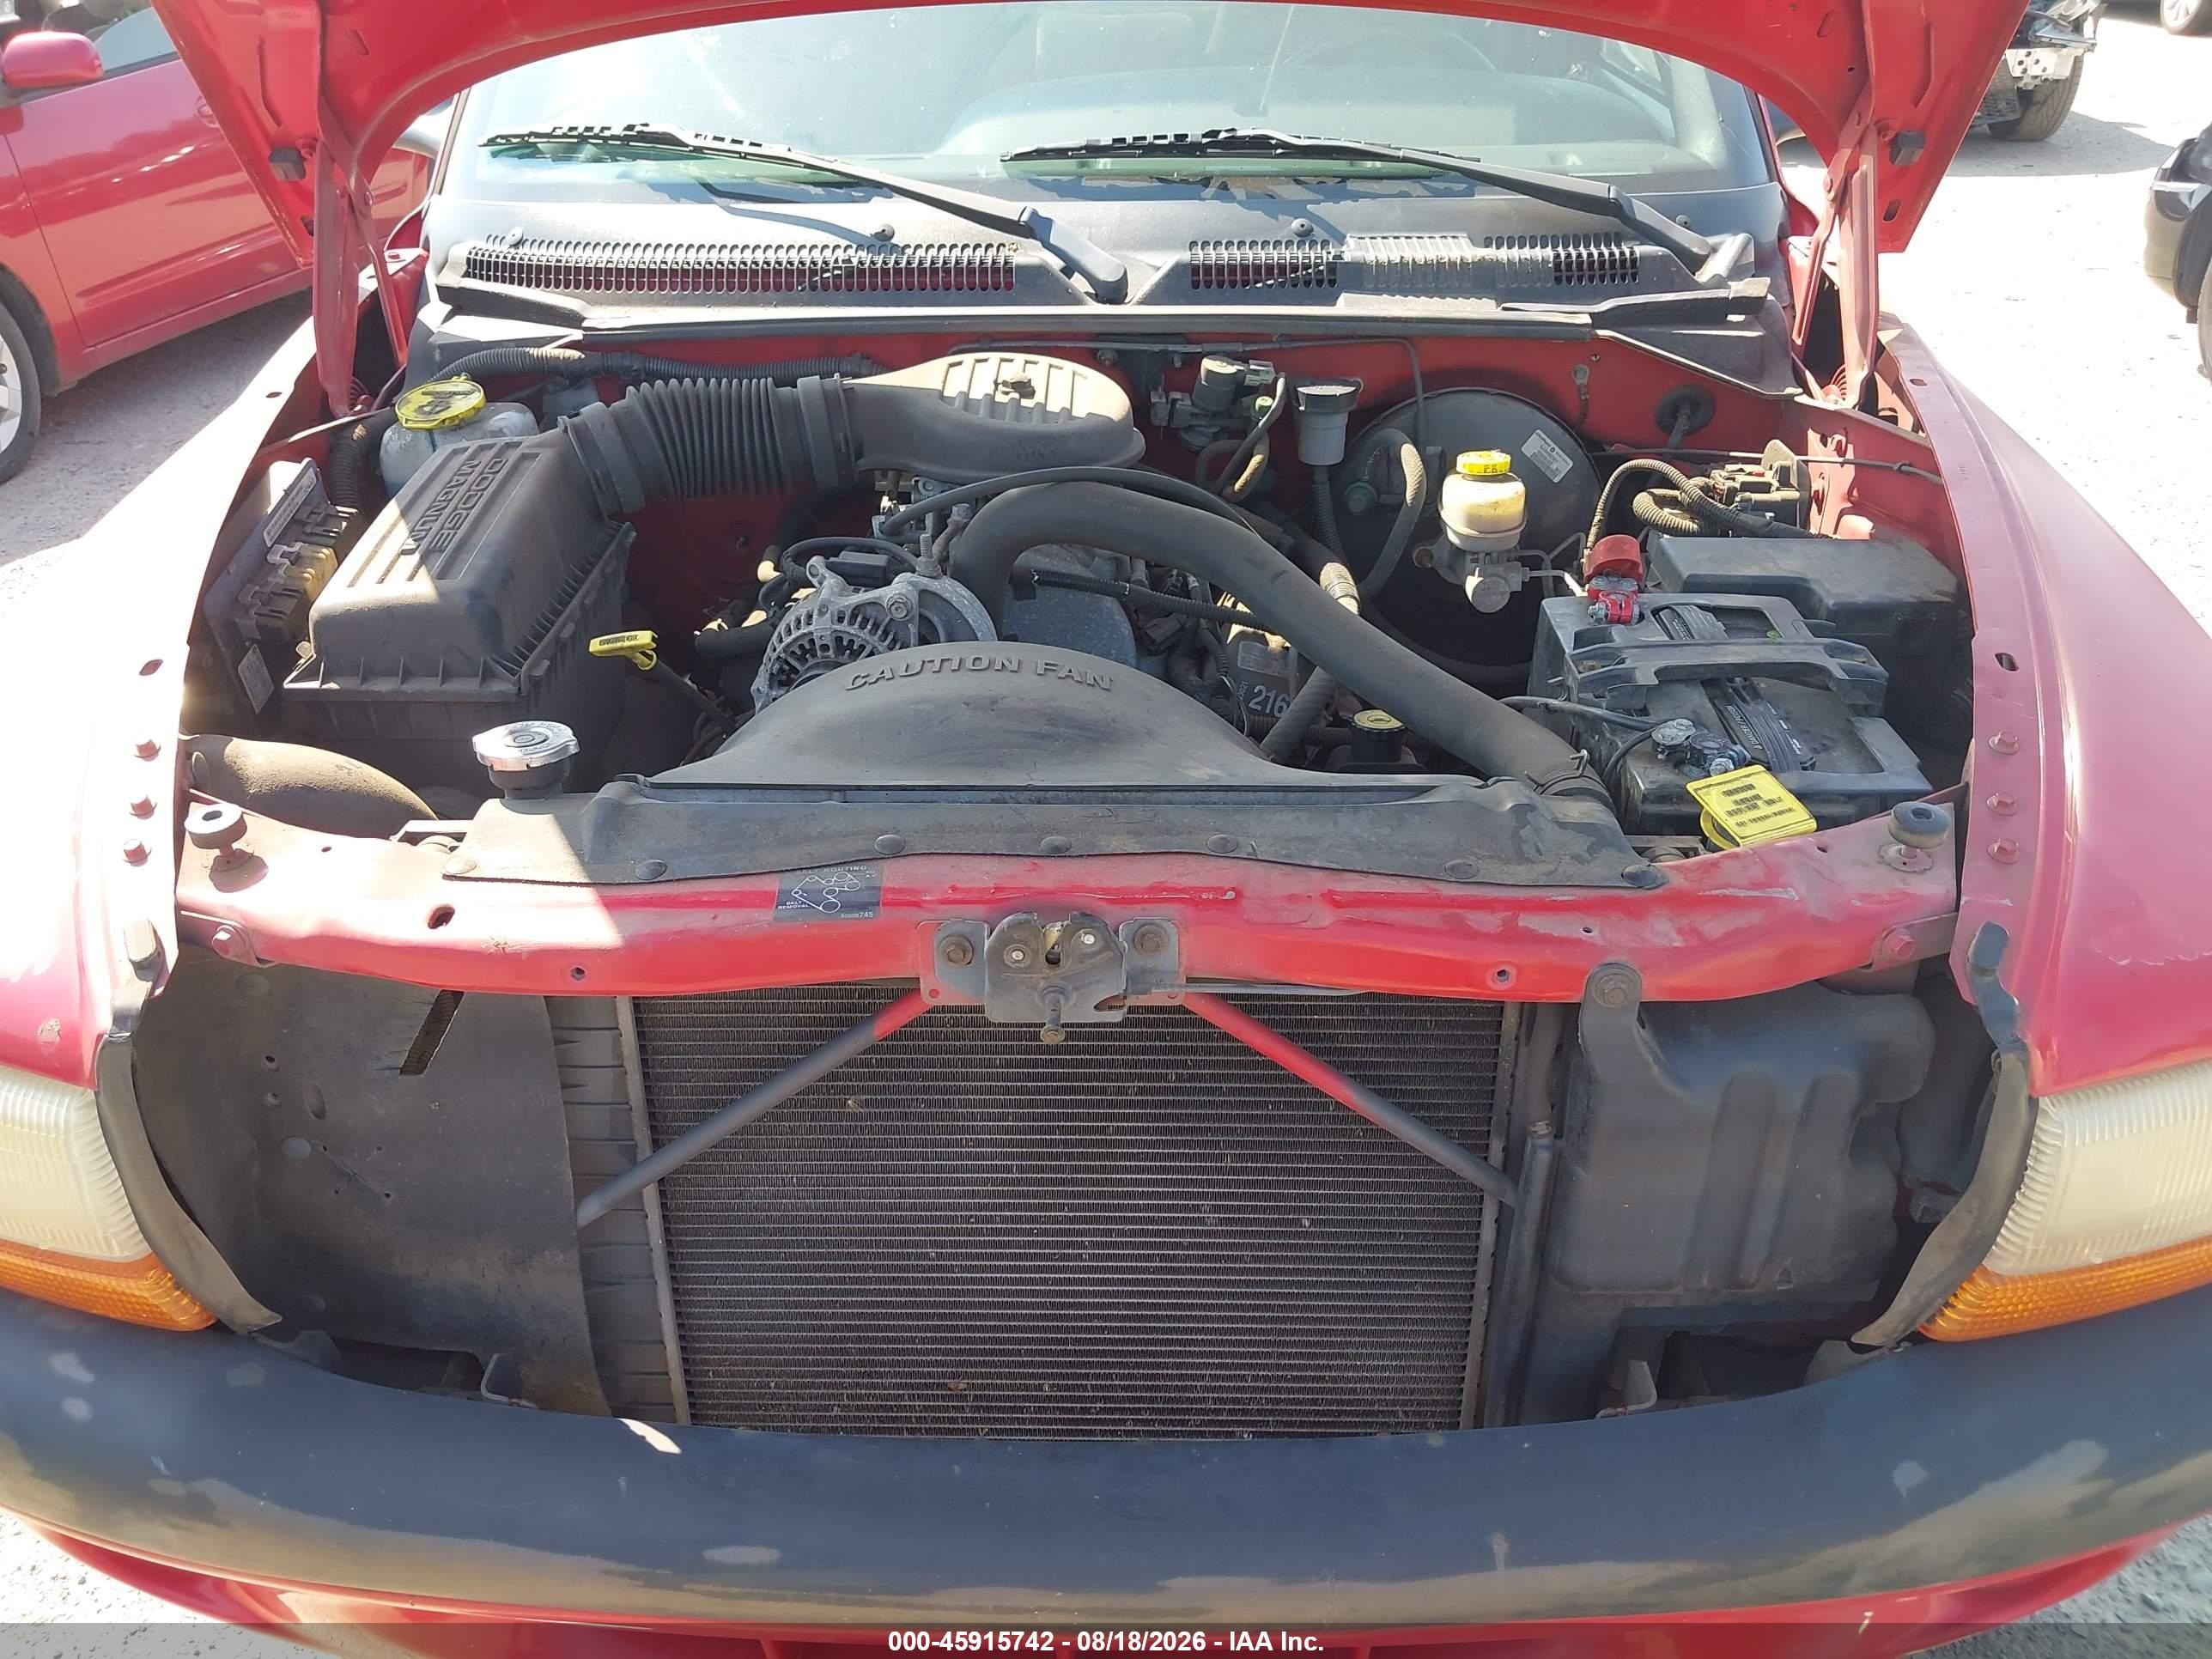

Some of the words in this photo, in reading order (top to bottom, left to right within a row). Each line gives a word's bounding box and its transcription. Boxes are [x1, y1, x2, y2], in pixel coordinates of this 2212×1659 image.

[399, 460, 482, 556] MAGNUM
[429, 458, 509, 552] DODGE
[845, 655, 1021, 690] CAUTION
[1036, 659, 1114, 690] FAN
[1249, 684, 1290, 718] 216
